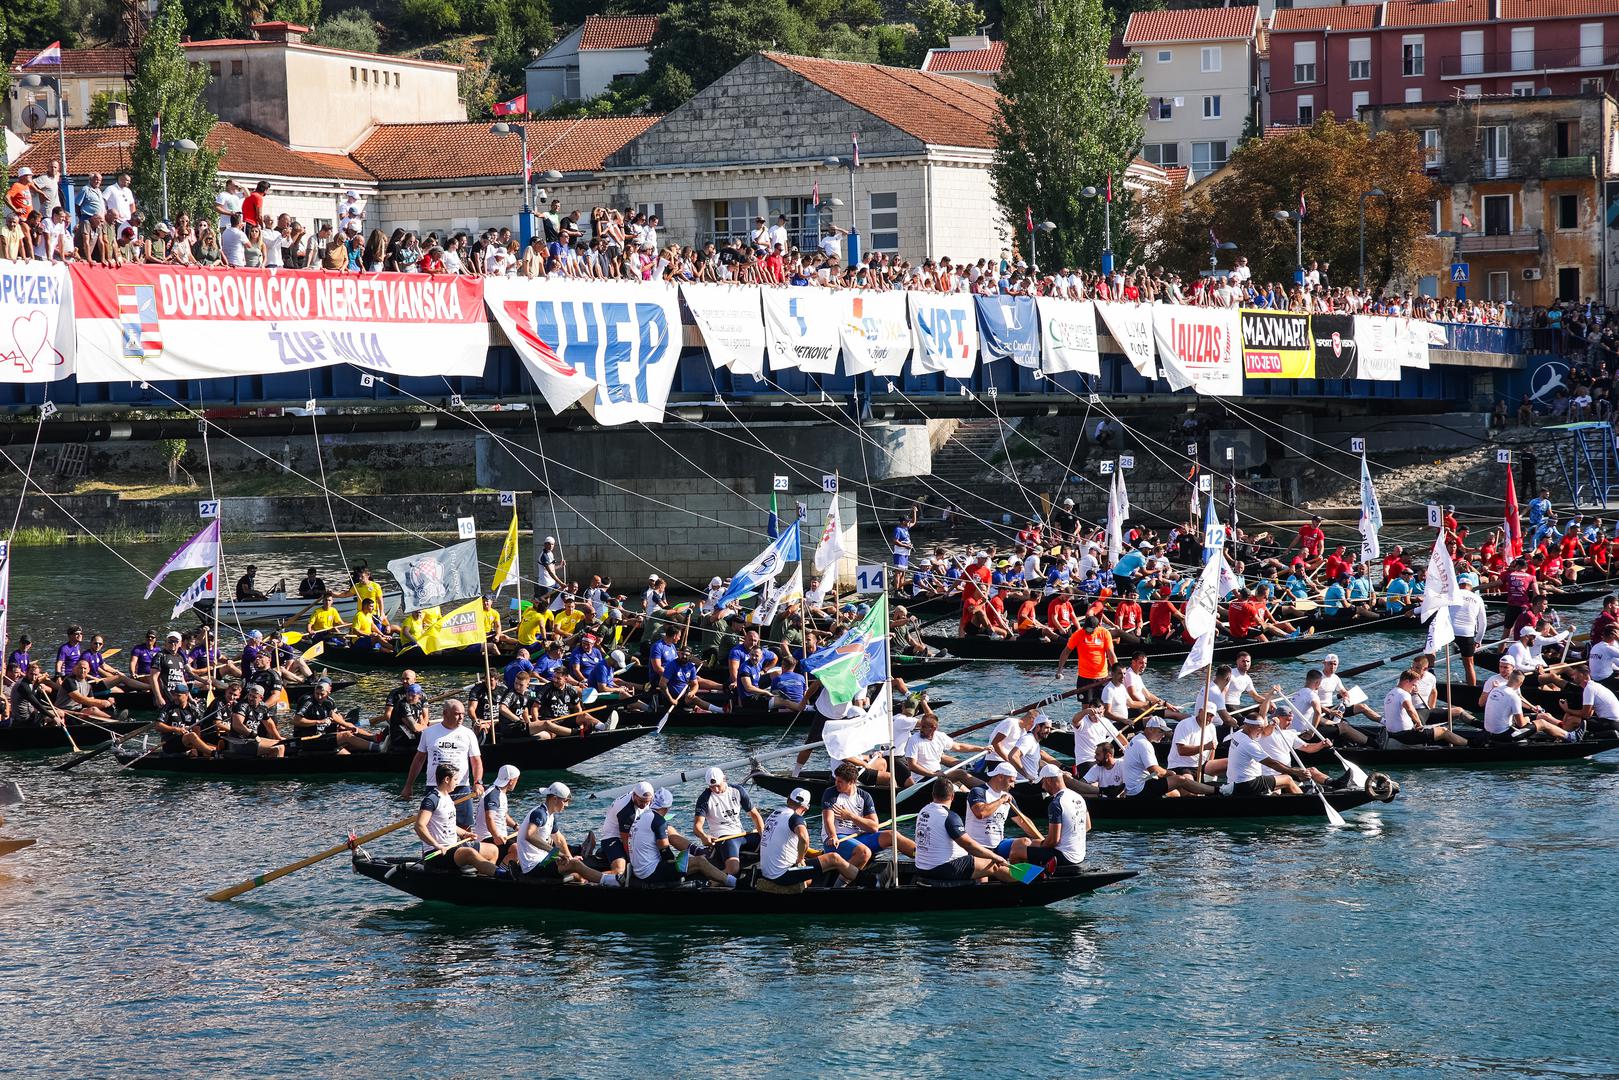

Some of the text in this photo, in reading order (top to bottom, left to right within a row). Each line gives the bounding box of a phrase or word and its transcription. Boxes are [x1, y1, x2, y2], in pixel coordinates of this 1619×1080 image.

[0, 274, 59, 304] PUZEN
[159, 269, 464, 320] DUBROVAČKO NERETVANSKA
[917, 307, 968, 358] HRT
[1242, 316, 1306, 347] MAXMART
[268, 322, 392, 368] ŽUPNIJA
[1171, 318, 1221, 363] LALIZAS
[1316, 338, 1332, 347] SPORT
[561, 301, 669, 405] HEP
[1250, 355, 1261, 369] TO
[1270, 355, 1281, 370] TO
[364, 377, 370, 385] 6
[44, 404, 53, 414] 27
[1352, 441, 1364, 451] 10
[1102, 463, 1113, 472] 25
[1121, 458, 1133, 467] 26
[775, 479, 788, 488] 23
[824, 479, 836, 488] 16
[1201, 479, 1210, 487] 13
[502, 494, 513, 503] 24
[201, 503, 217, 514] 27
[1431, 510, 1437, 523] 8
[460, 522, 473, 534] 19
[1207, 529, 1223, 545] 12
[858, 571, 883, 589] 14
